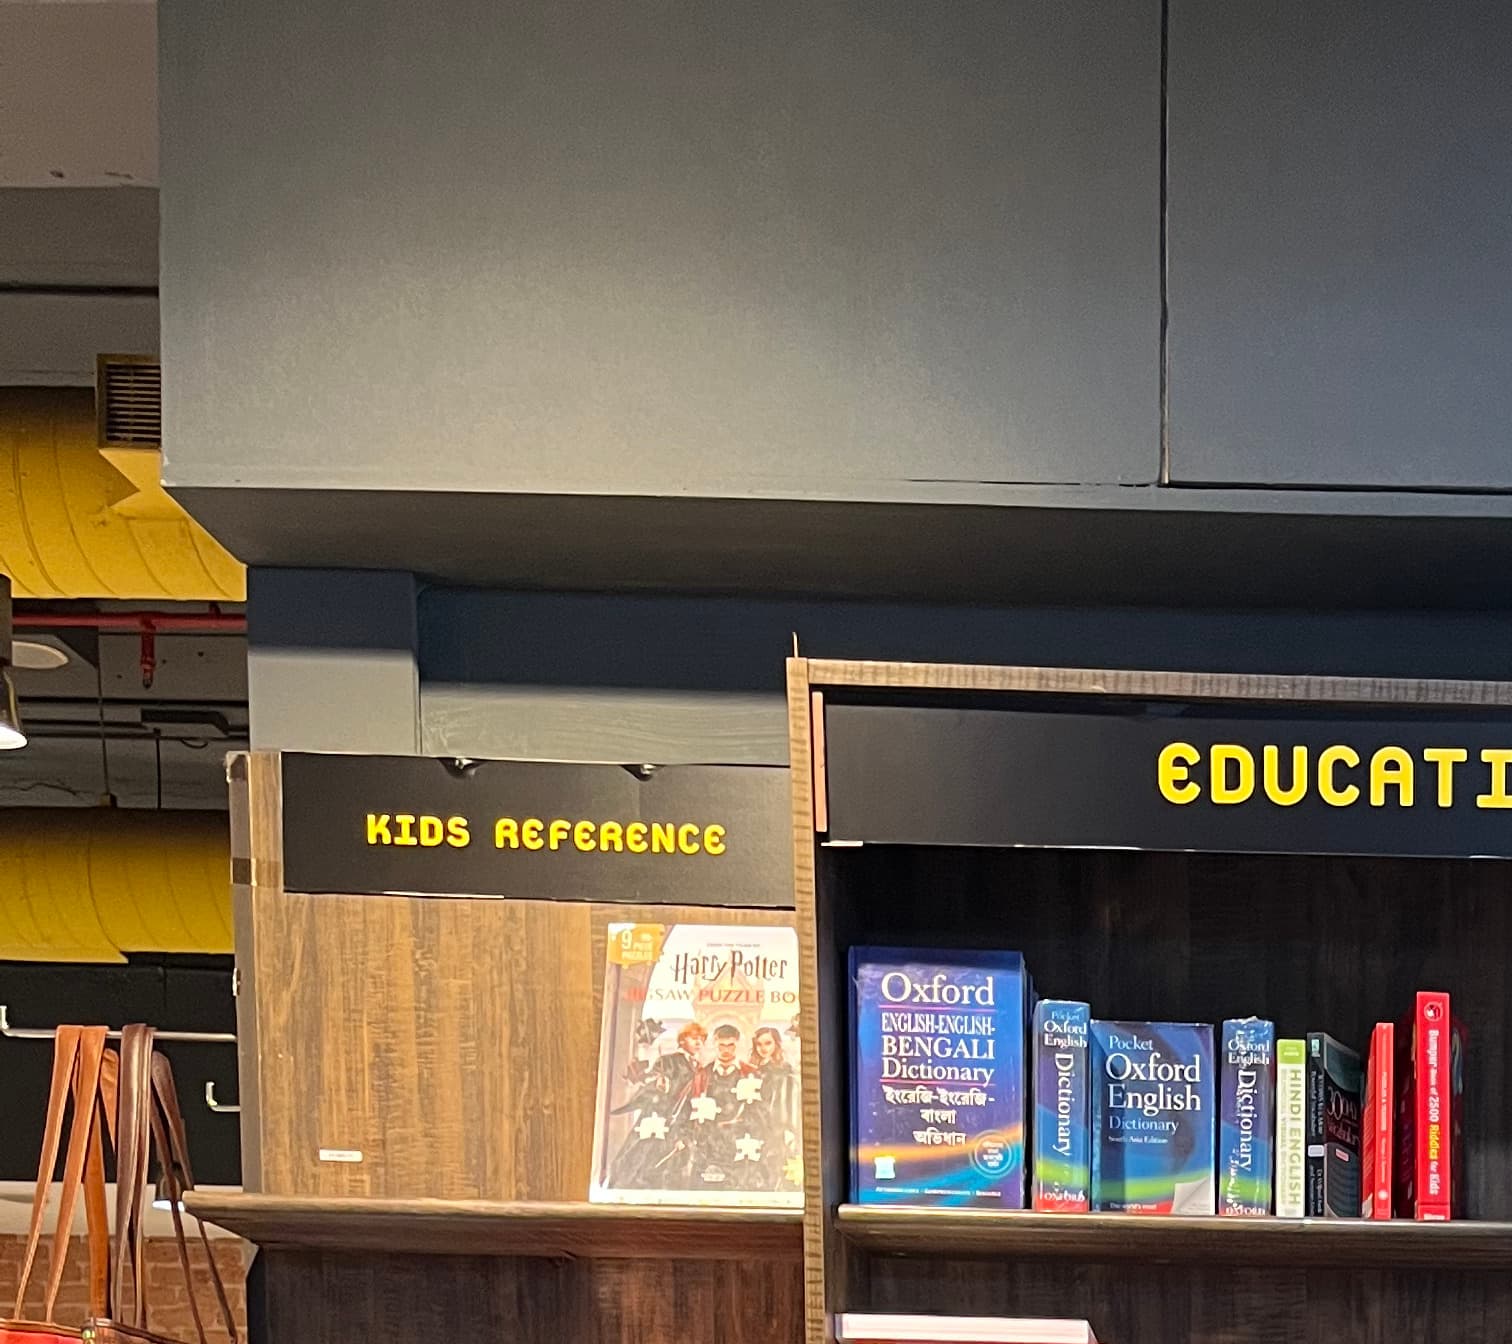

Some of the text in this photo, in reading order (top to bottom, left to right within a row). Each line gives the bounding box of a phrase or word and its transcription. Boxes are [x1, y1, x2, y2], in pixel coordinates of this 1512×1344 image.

[366, 813, 727, 855] KIDS REFERENCE
[671, 950, 788, 986] Harry Potter
[698, 989, 765, 1001] PUZZLE
[881, 972, 995, 1006] Oxford
[1043, 1019, 1087, 1035] Oxford
[1043, 1033, 1088, 1049] English
[881, 1035, 995, 1060] BENGALI
[1108, 1035, 1154, 1051] Pocket
[881, 1057, 995, 1087] Dictionary
[1105, 1052, 1201, 1083] Oxford
[1052, 1052, 1076, 1157] Dictionary
[1108, 1083, 1201, 1117] English
[1108, 1116, 1179, 1138] Dictionary
[1236, 1068, 1259, 1172] Dictionary
[1289, 1069, 1302, 1206] HINDI ENGLISH
